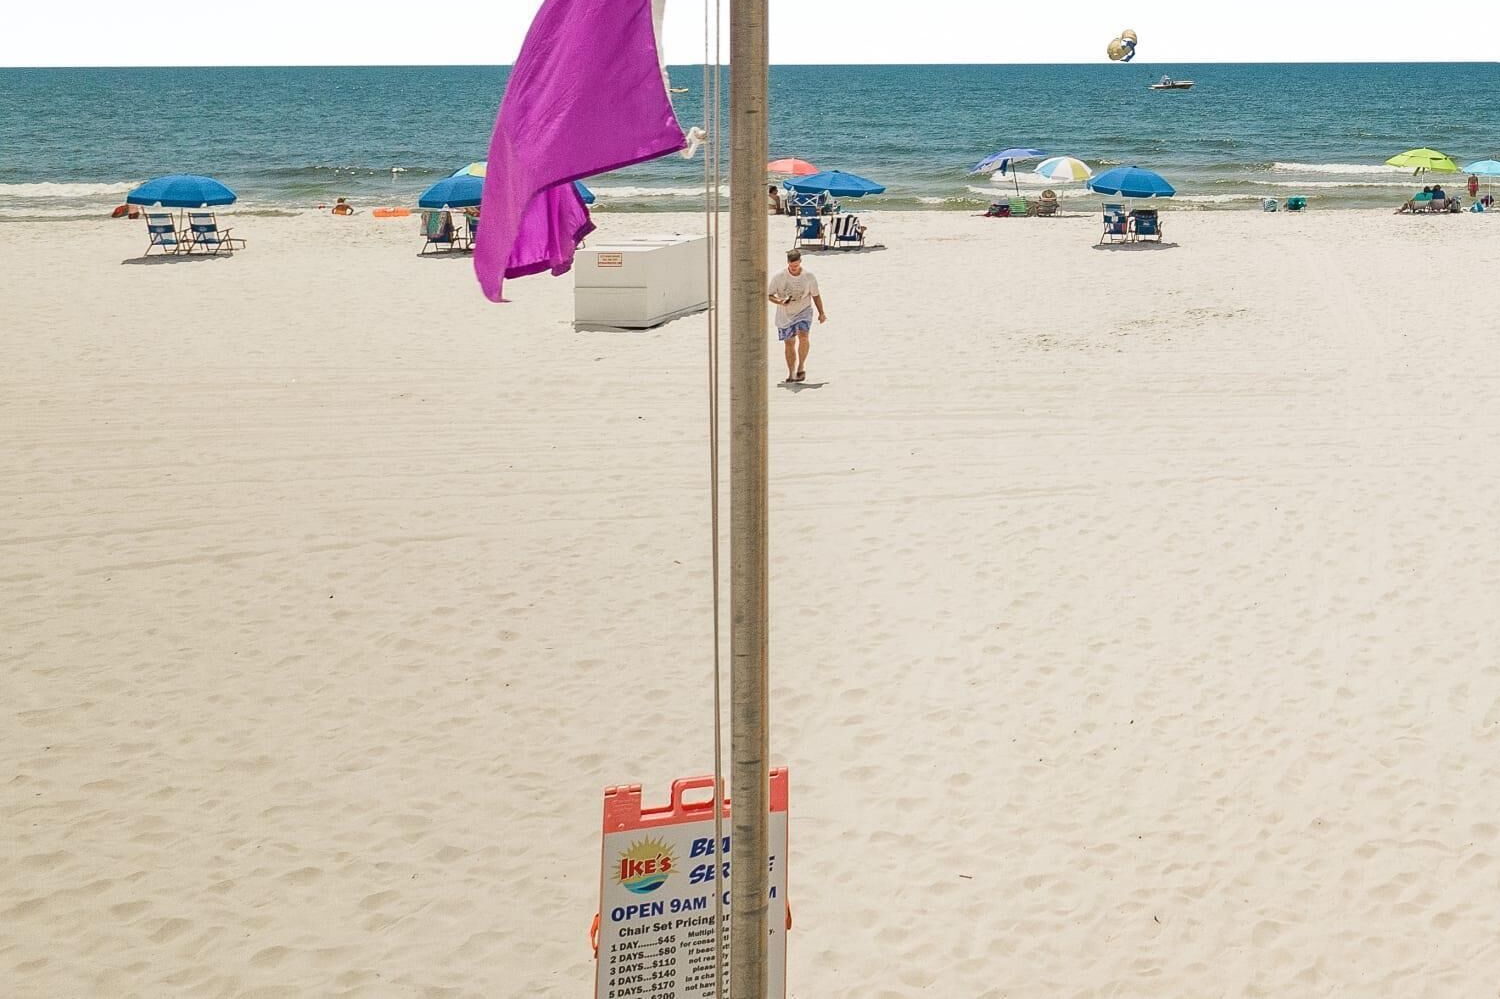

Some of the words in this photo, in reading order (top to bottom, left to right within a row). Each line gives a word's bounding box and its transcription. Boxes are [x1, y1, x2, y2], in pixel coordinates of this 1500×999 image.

[621, 853, 672, 880] IKE'S
[611, 901, 664, 922] OPEN
[670, 896, 707, 913] 9AM
[619, 925, 651, 938] Chair
[653, 920, 673, 931] Set
[675, 915, 715, 928] Pricing
[611, 944, 618, 952] 1
[610, 956, 617, 964] 2
[609, 967, 616, 976] 3
[685, 983, 698, 991] not
[609, 990, 615, 998] 5
